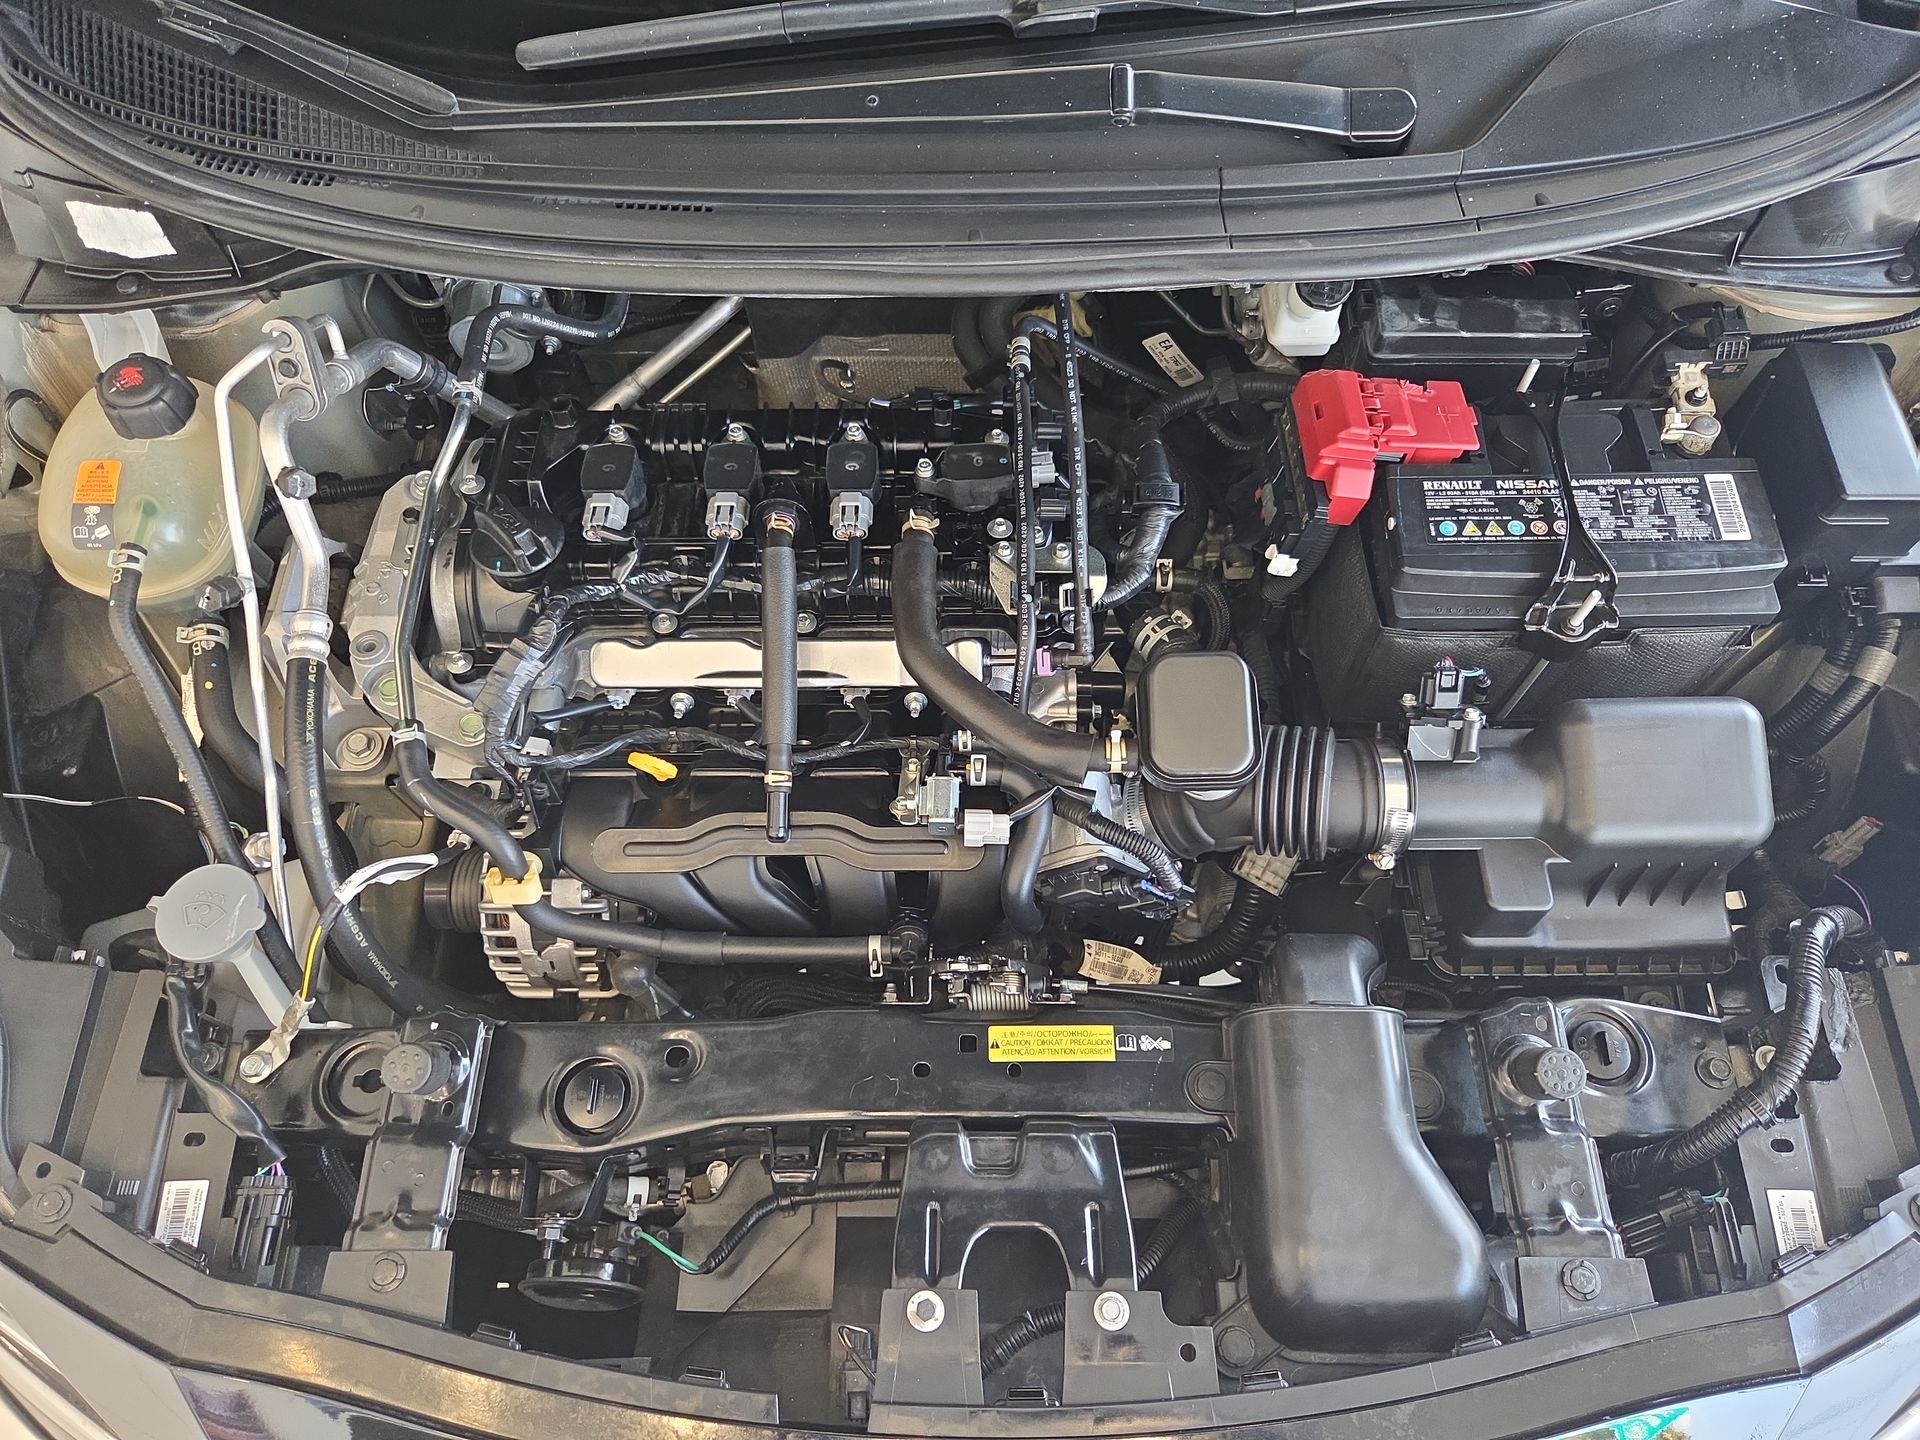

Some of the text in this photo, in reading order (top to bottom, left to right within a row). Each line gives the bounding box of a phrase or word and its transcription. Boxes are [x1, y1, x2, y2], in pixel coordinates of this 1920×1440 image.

[1158, 339, 1173, 351] EA
[1423, 481, 1482, 490] RENAULT
[1496, 480, 1559, 489] NISSAN
[306, 688, 315, 732] YOKOHAMA
[367, 951, 395, 983] YOKOHAMA
[1001, 1039, 1031, 1047] CAUTION
